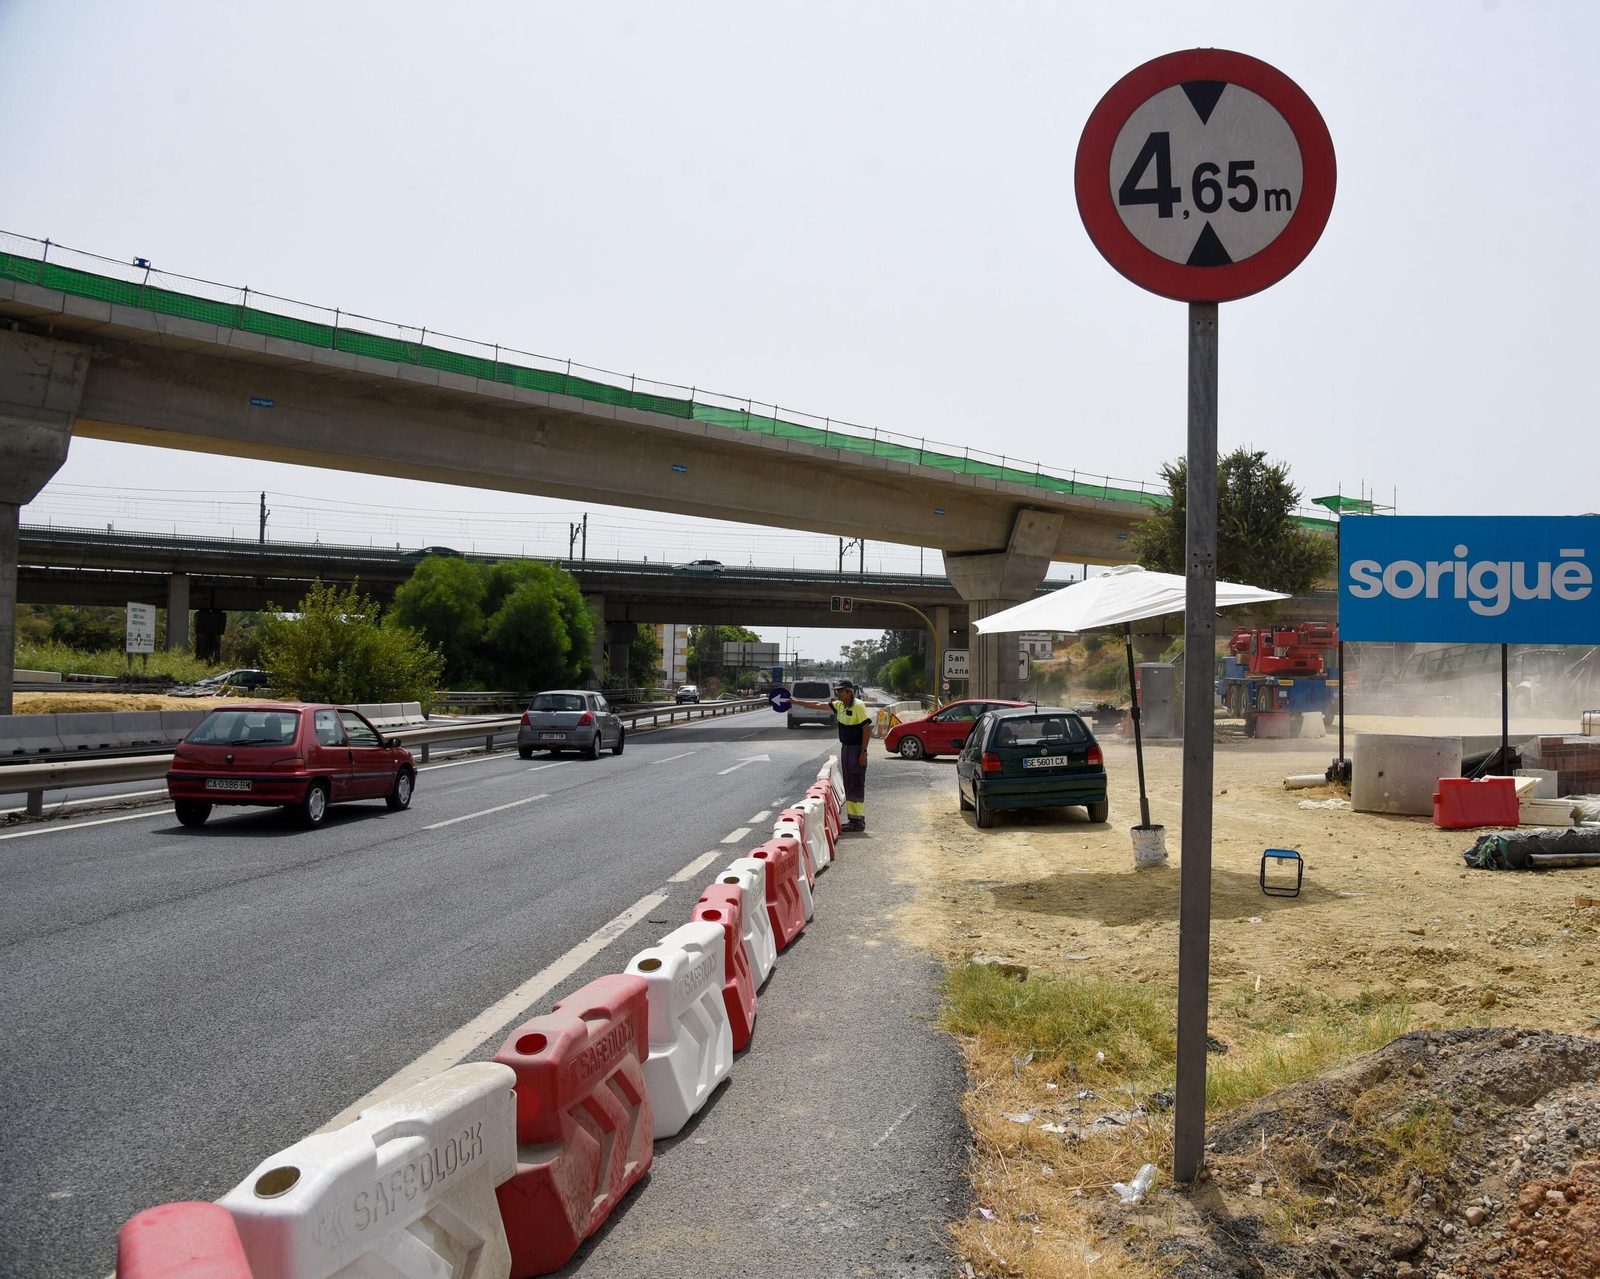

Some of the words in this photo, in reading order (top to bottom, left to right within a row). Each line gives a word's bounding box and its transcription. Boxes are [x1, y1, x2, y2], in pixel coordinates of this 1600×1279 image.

[948, 654, 965, 662] San
[1027, 758, 1036, 767] SE
[1037, 758, 1054, 766] 5601
[1055, 757, 1065, 765] CX
